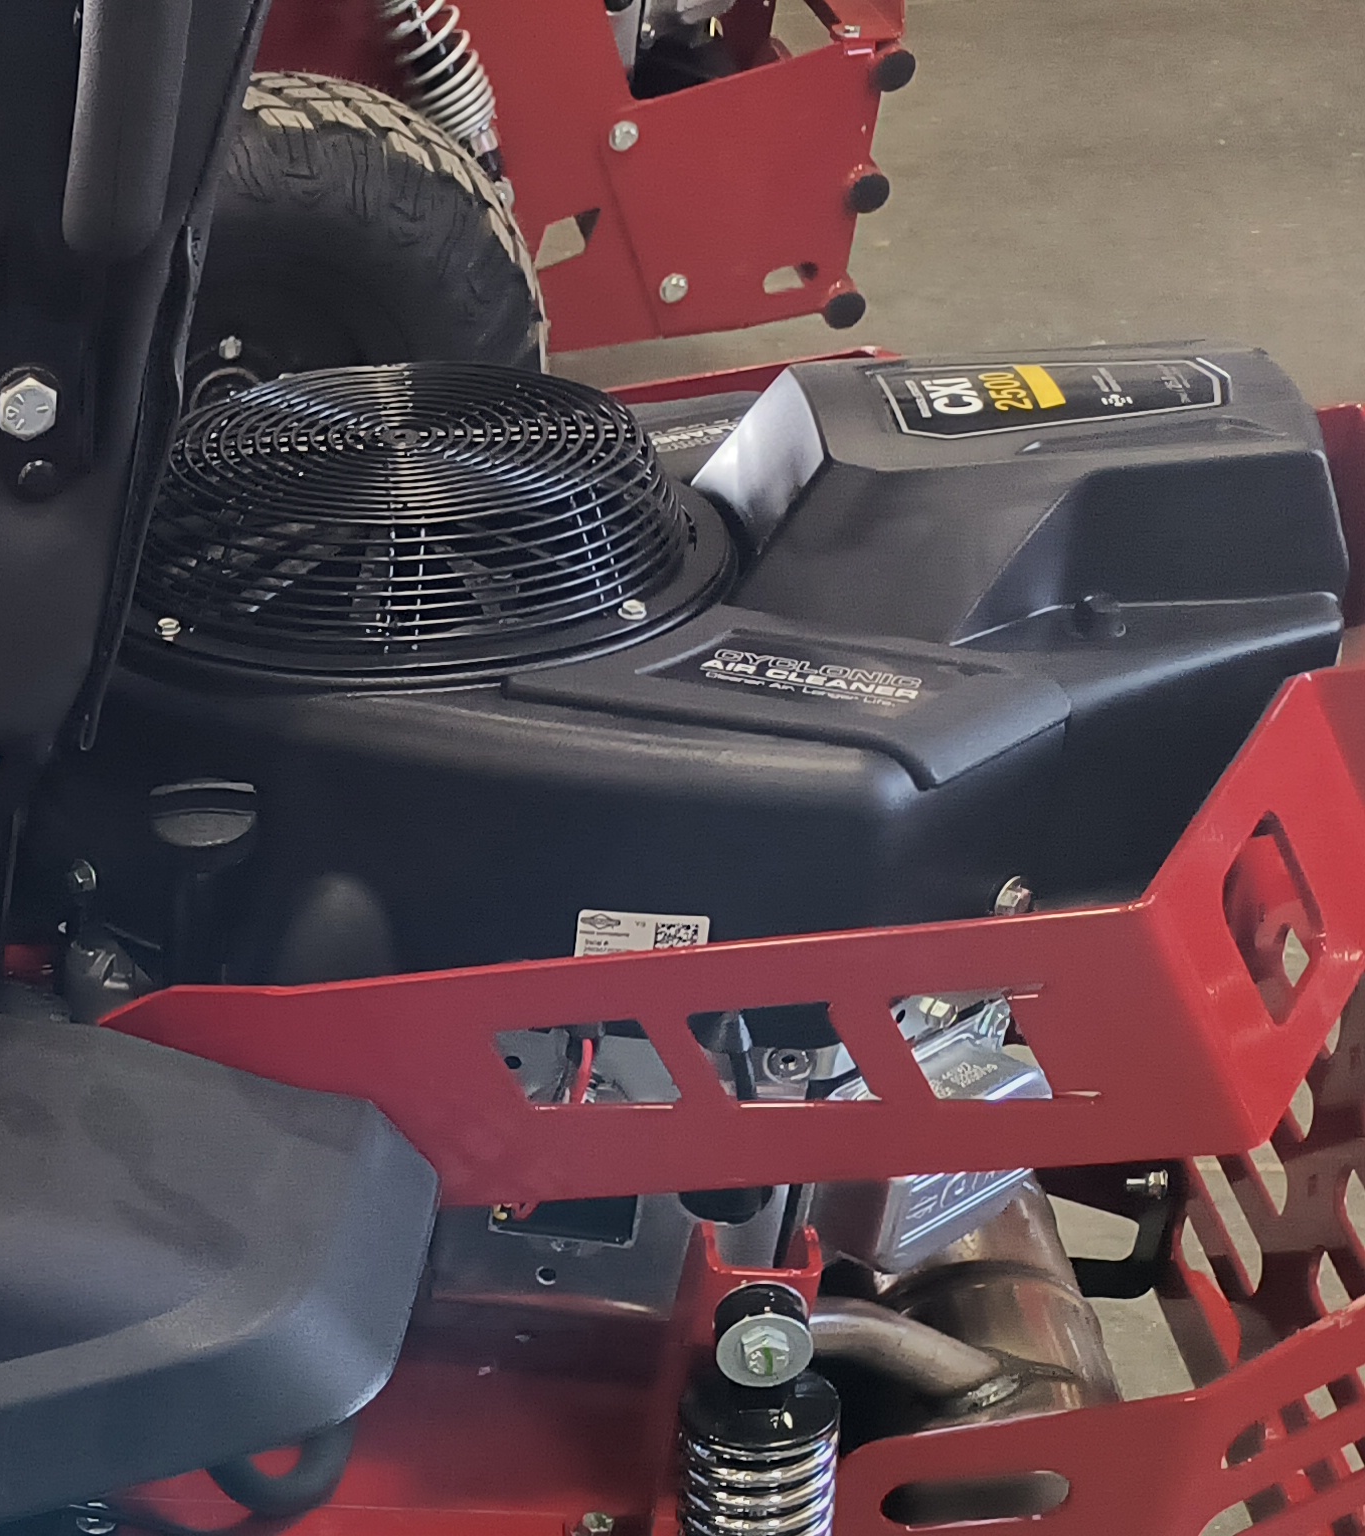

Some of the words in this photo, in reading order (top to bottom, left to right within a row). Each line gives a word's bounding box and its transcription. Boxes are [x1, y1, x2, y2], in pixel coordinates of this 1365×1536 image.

[921, 377, 984, 415] CXi
[978, 372, 1033, 412] 2500
[700, 659, 756, 674] AIR
[766, 668, 919, 700] CLEANER
[706, 671, 766, 687] Cleaner
[714, 649, 922, 688] CYCLONIC
